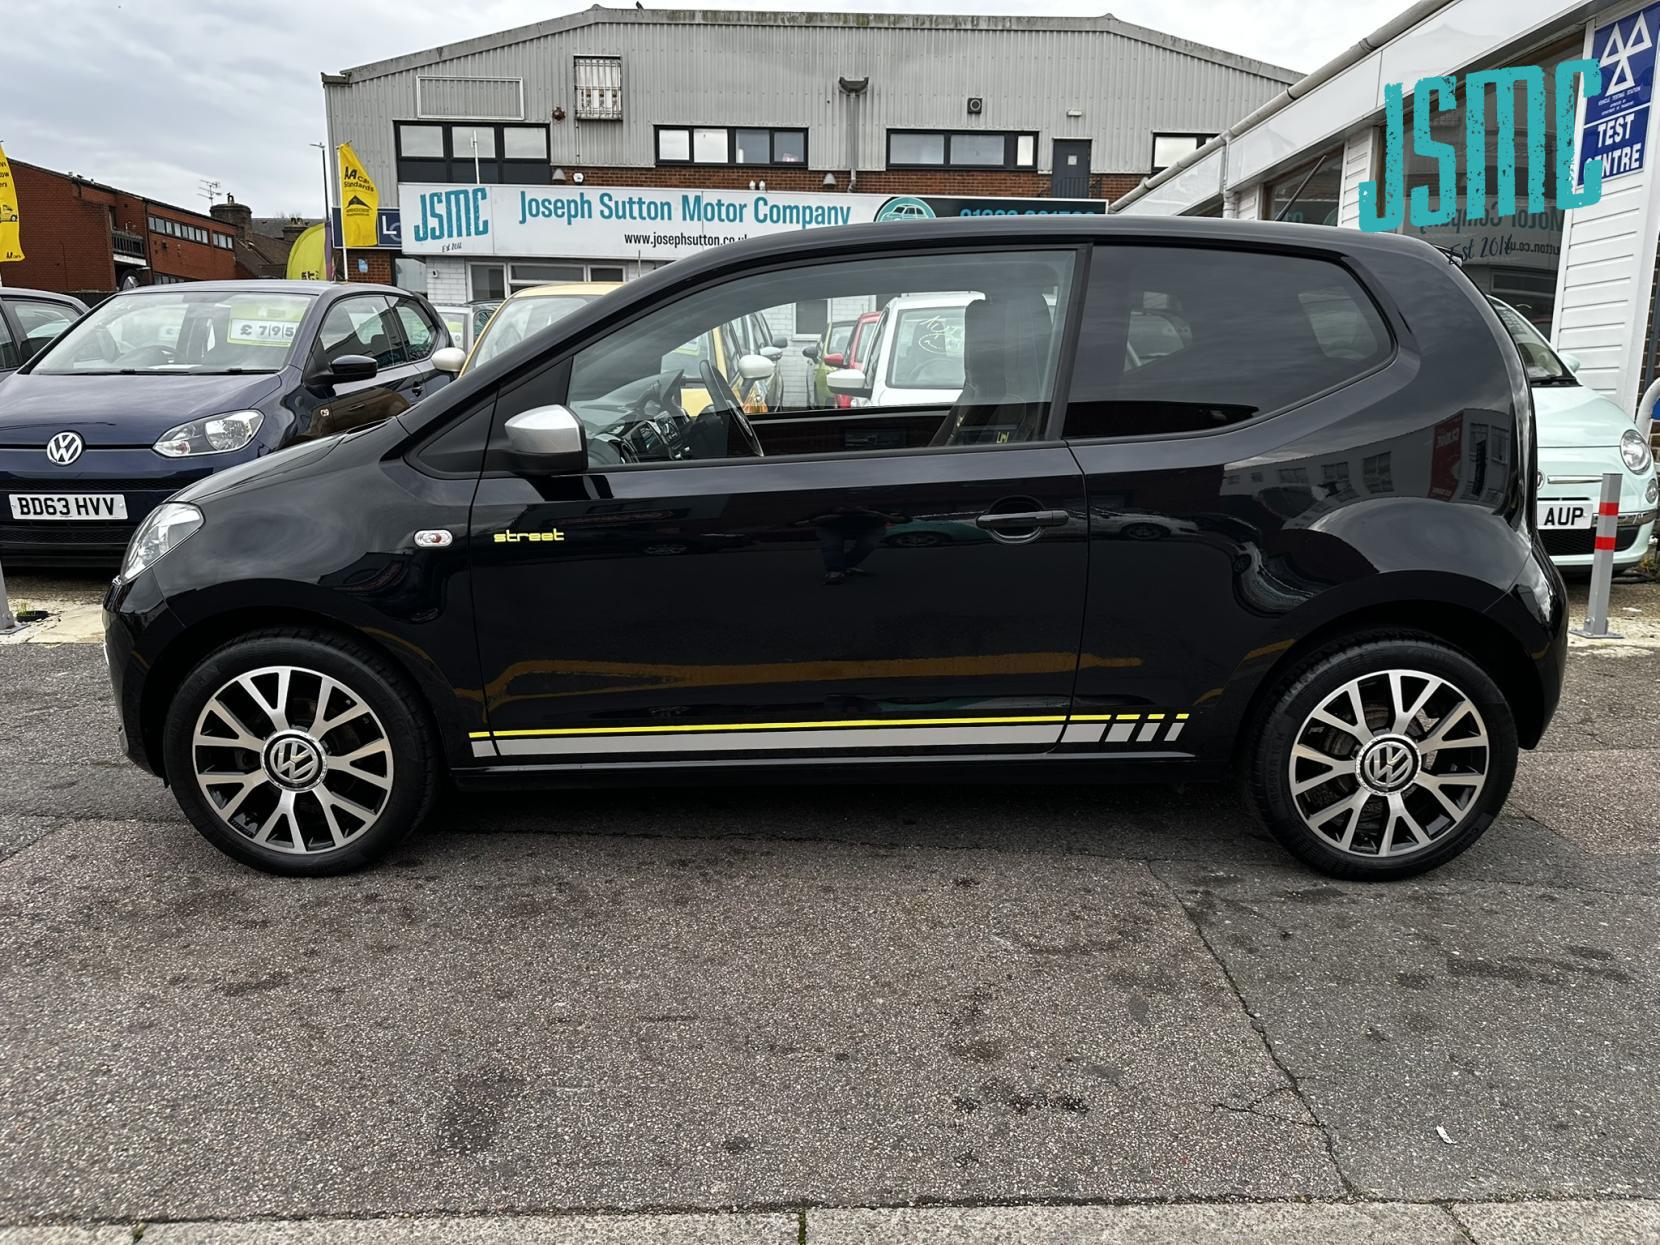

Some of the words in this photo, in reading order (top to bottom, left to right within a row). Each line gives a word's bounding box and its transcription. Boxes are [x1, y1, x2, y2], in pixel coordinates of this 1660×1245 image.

[1597, 113, 1635, 148] TEST
[1586, 142, 1642, 177] NTRE
[413, 187, 489, 242] JSMC
[519, 191, 592, 225] Joseph
[600, 193, 672, 221] Sutton
[681, 195, 747, 223] Motor
[754, 197, 852, 230] Company
[17, 497, 70, 515] BD63
[75, 497, 114, 515] HVV
[1543, 506, 1584, 526] AUP
[494, 528, 564, 543] street
